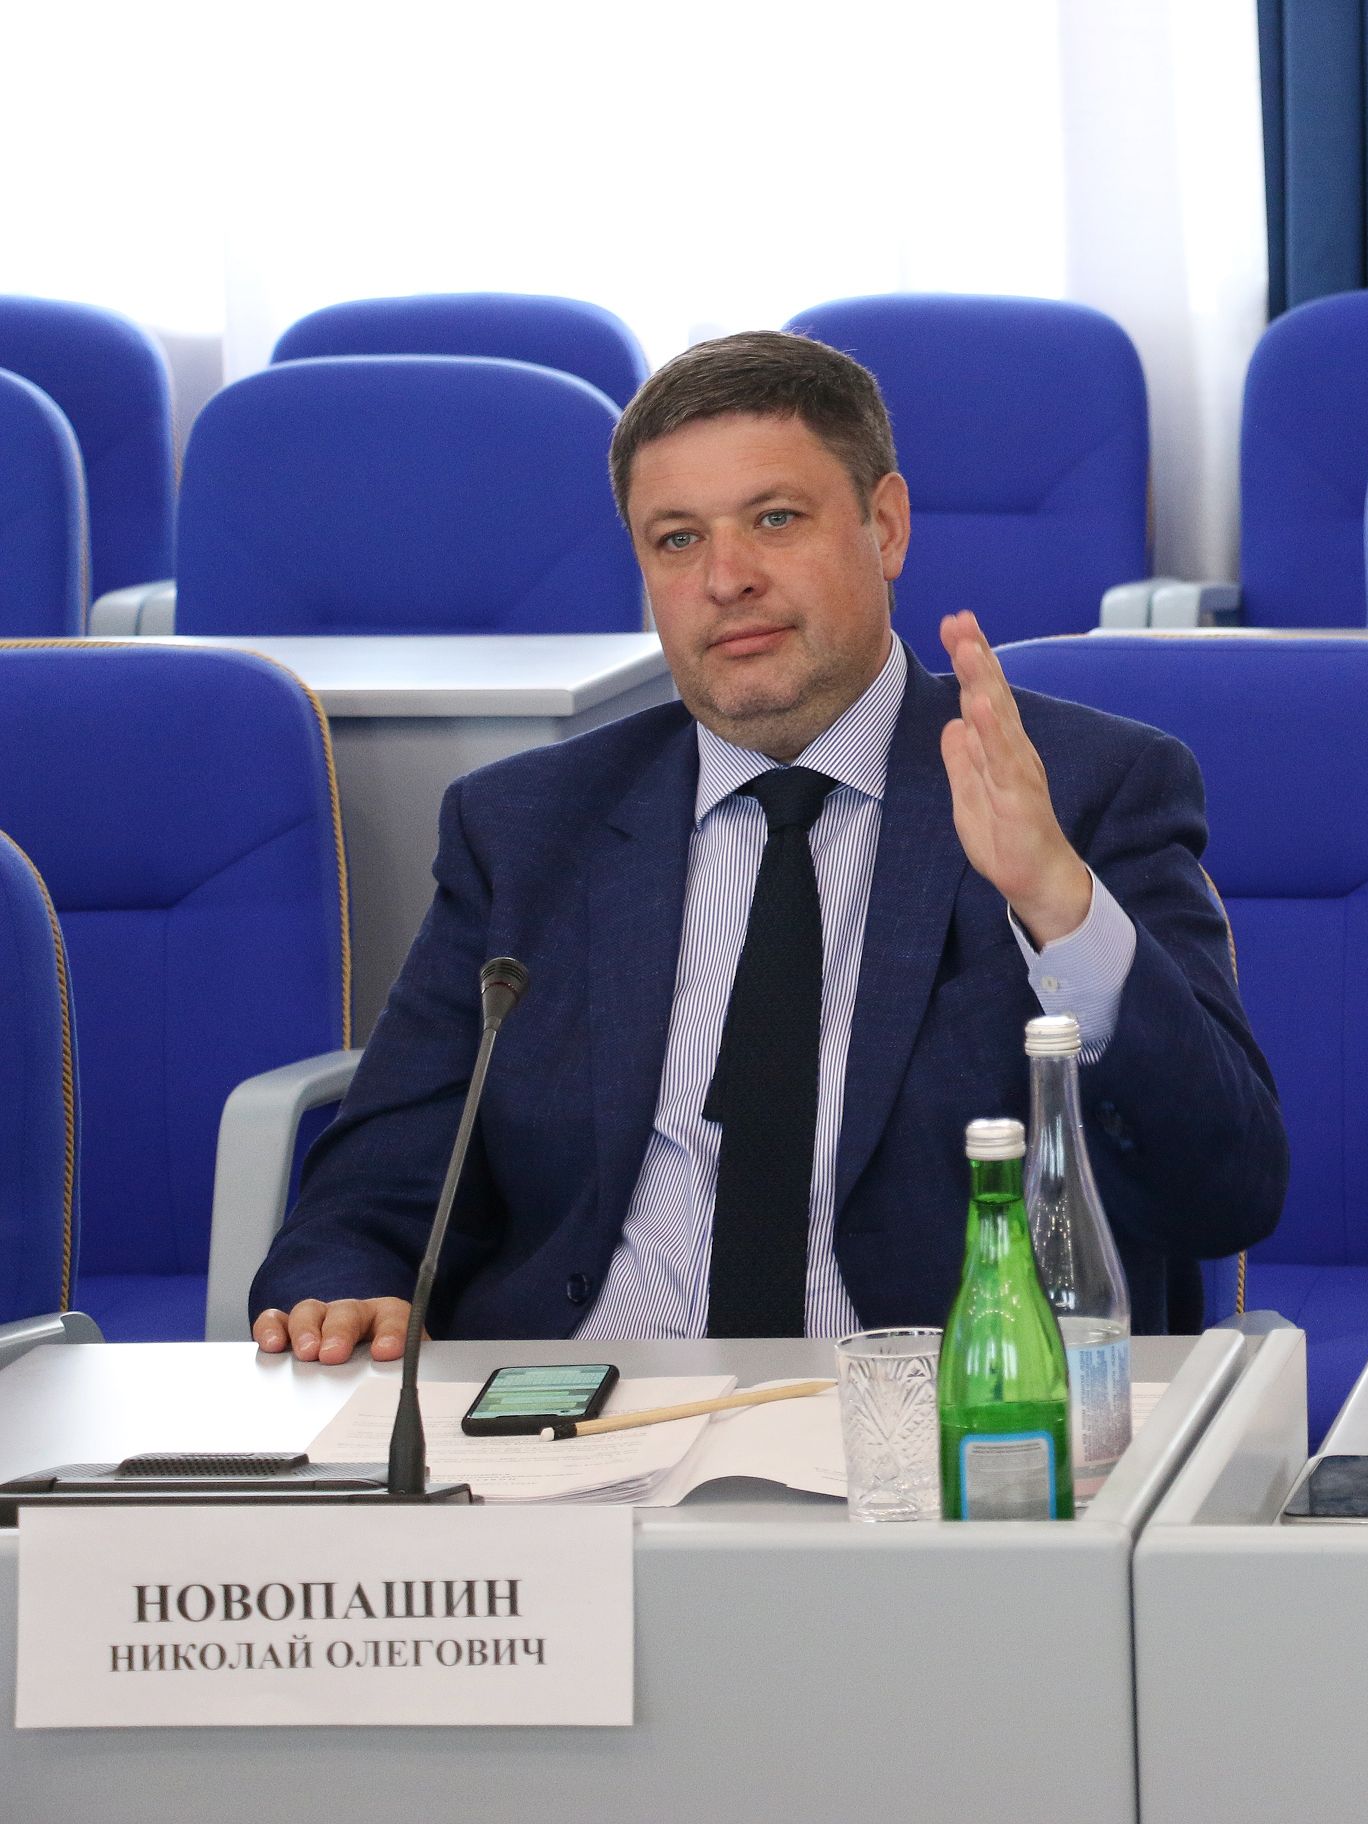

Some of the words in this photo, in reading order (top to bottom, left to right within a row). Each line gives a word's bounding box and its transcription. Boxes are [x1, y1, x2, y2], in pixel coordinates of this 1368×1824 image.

[133, 1578, 523, 1623] НОВОПАШИН
[109, 1634, 314, 1672] НИКОЛАЙ
[326, 1637, 547, 1669] ОЛЕГОВИЧ
